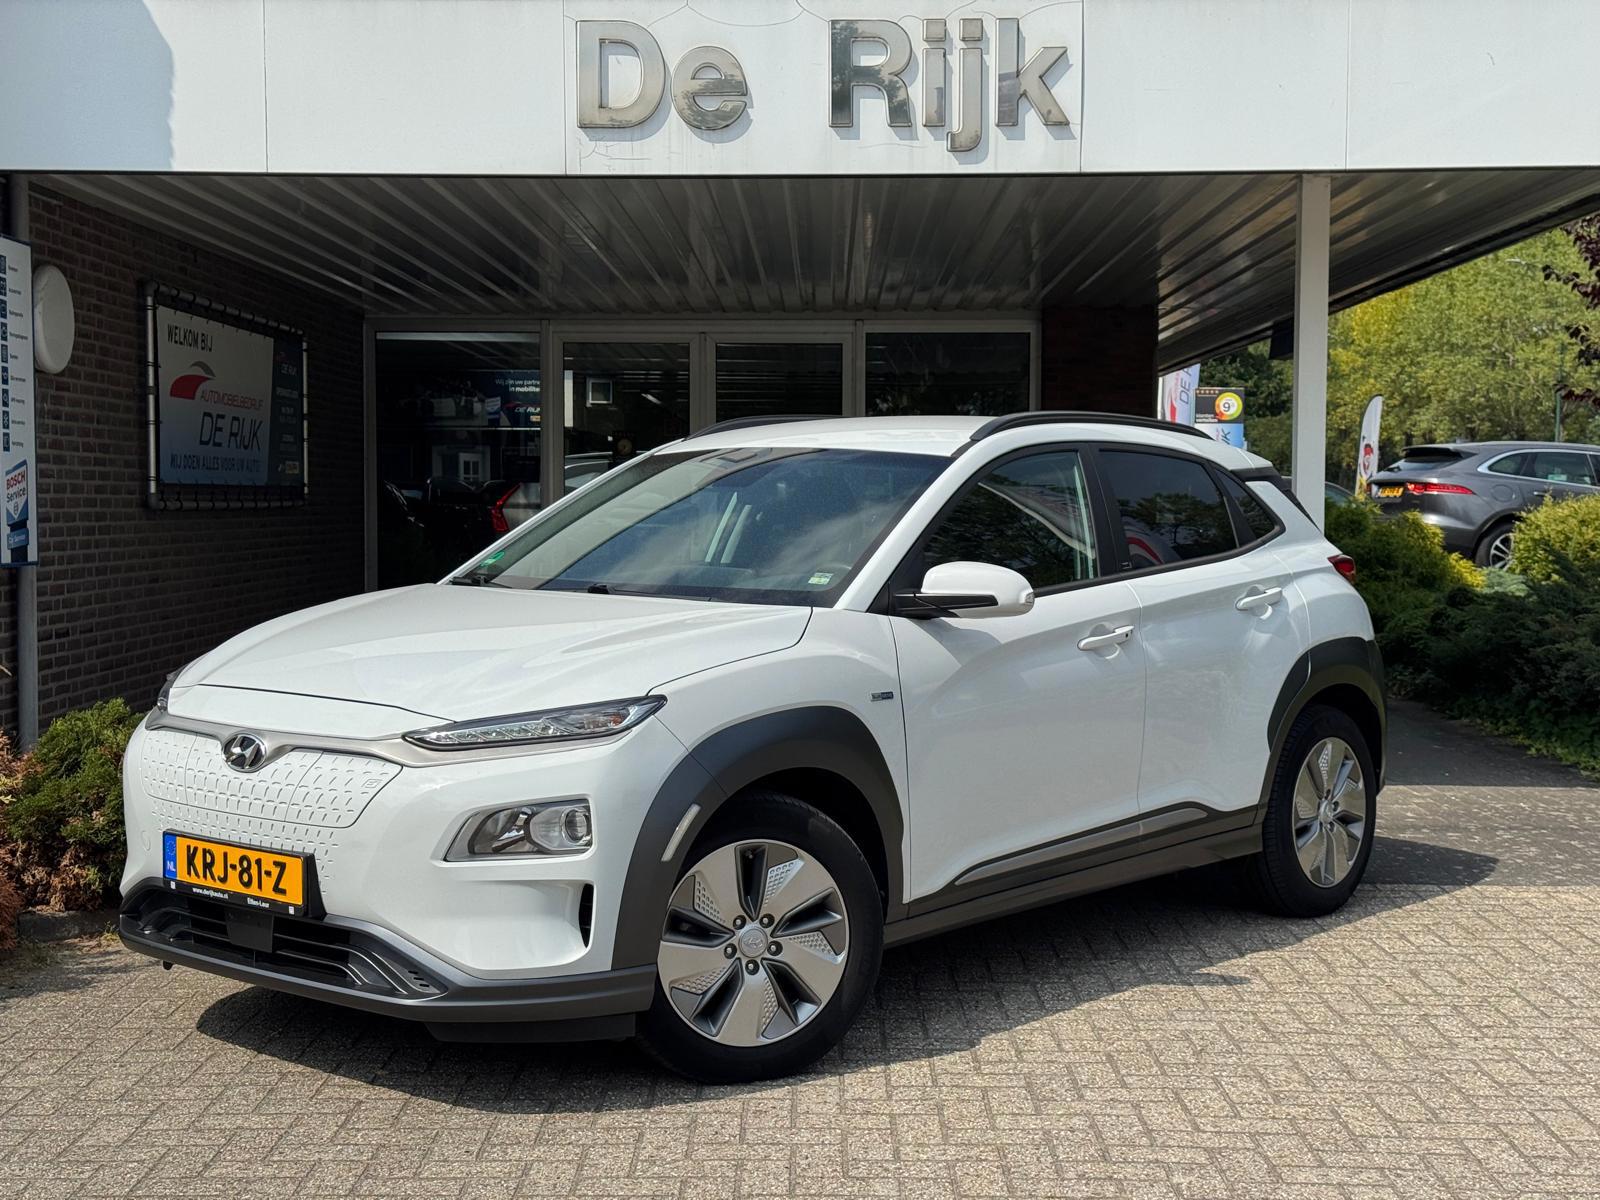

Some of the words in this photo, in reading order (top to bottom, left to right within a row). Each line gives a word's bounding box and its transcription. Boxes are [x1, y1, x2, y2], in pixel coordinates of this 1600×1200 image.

[575, 19, 748, 131] De
[828, 18, 1070, 152] Rijk
[167, 323, 199, 350] WELKOM
[201, 333, 213, 352] BIJ
[1180, 378, 1191, 405] DE
[199, 411, 226, 448] DE
[228, 415, 263, 451] RIJK
[170, 453, 182, 469] WIJ
[183, 454, 200, 471] DOEN
[201, 455, 220, 471] ALLES
[6, 470, 26, 490] BOSCH
[6, 487, 26, 503] Service
[167, 861, 176, 873] NL
[186, 844, 287, 896] KRJ-81-Z
